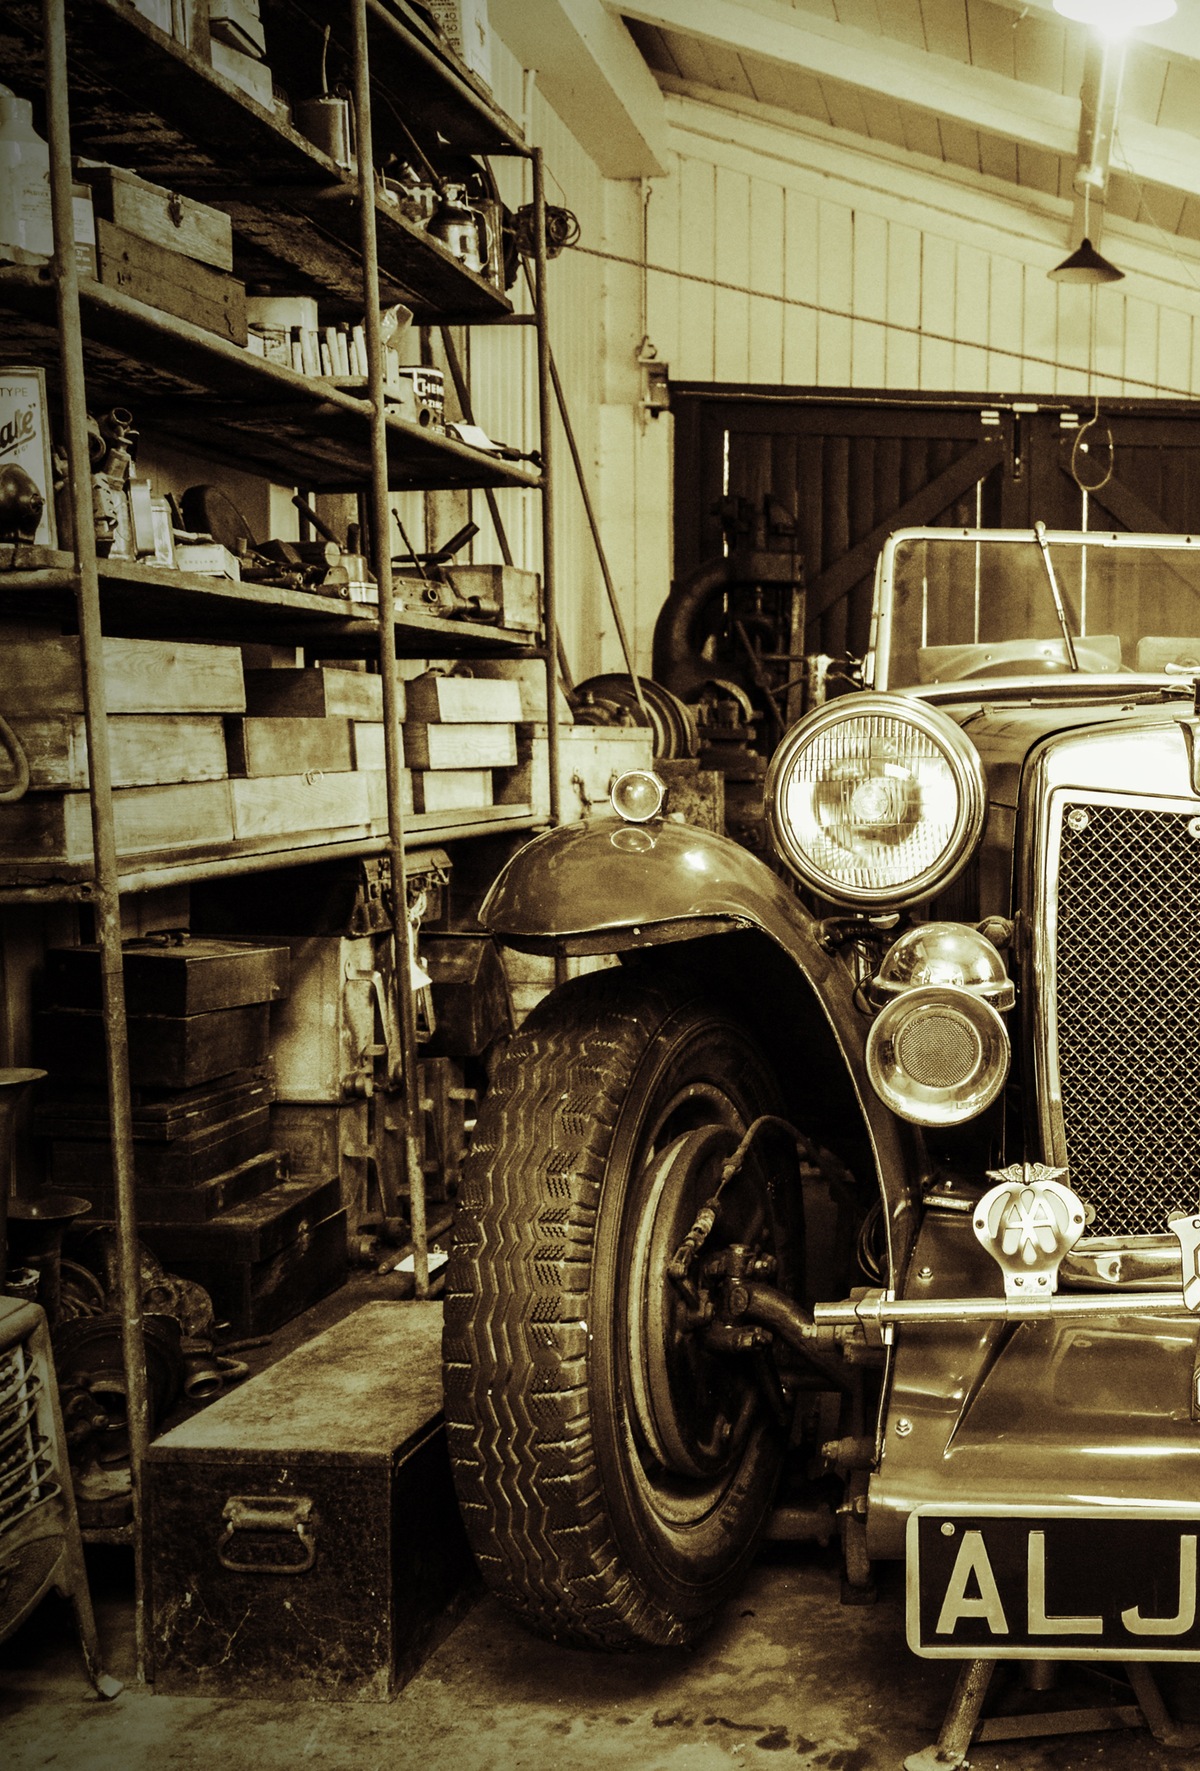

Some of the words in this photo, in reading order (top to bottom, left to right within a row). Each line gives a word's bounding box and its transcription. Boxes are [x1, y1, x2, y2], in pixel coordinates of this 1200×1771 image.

[0, 387, 29, 397] TYPE
[1001, 1201, 1055, 1256] AA
[936, 1530, 1198, 1636] ALJ
